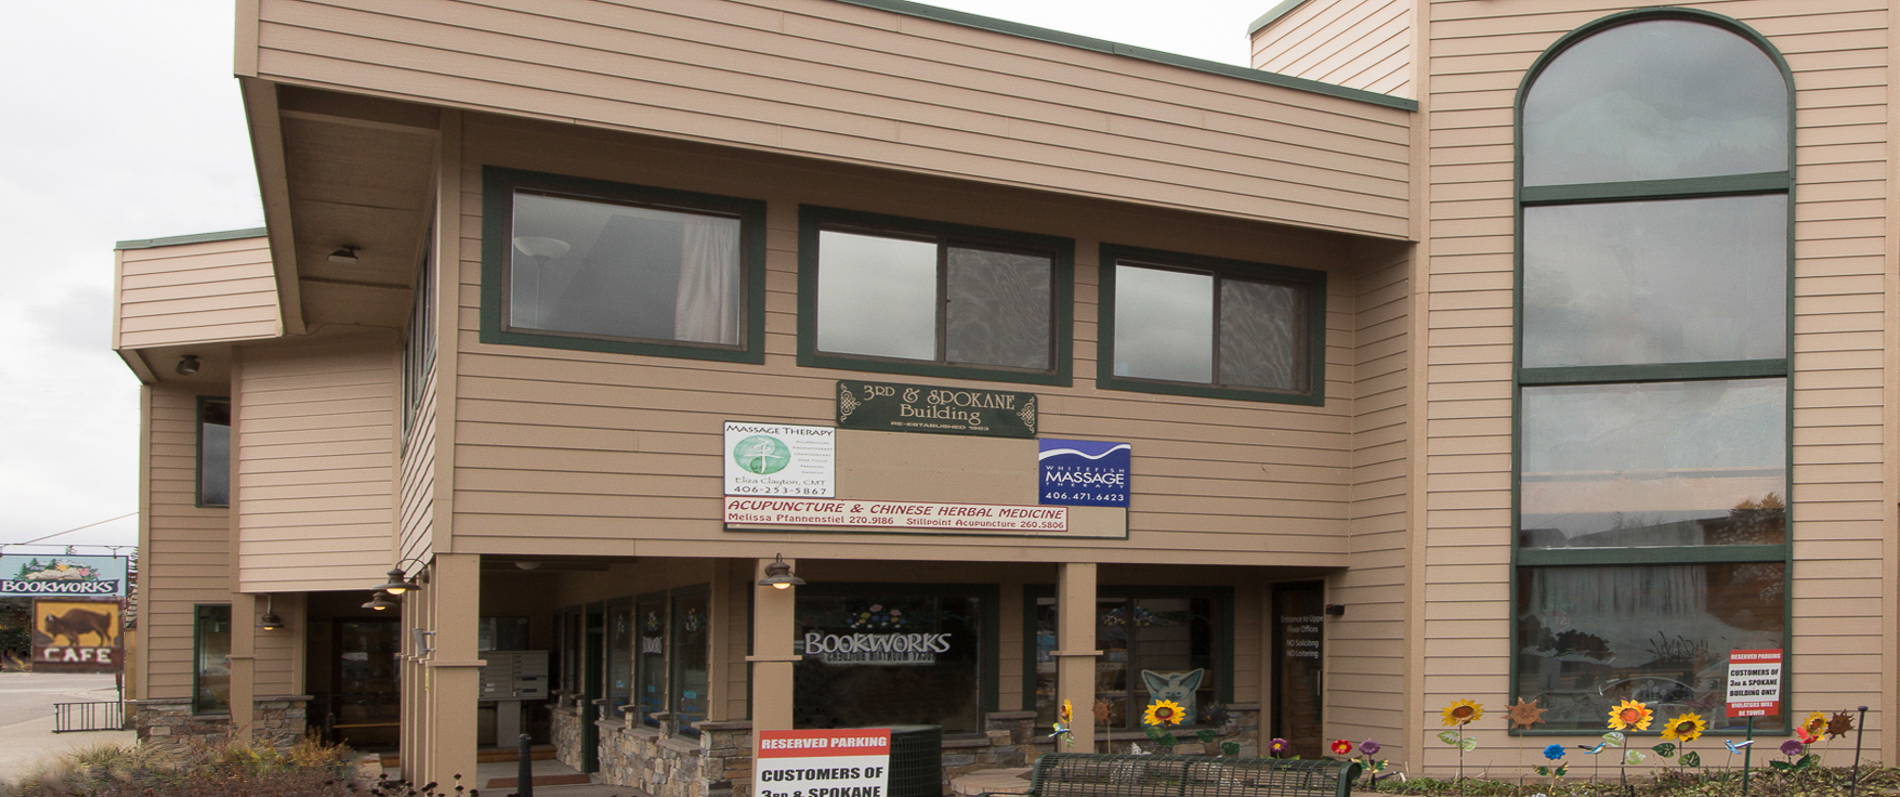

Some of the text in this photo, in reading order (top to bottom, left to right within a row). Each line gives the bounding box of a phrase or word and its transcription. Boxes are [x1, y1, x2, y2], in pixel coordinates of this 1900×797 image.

[863, 384, 1016, 411] 3RD & SPOKANE
[900, 403, 982, 426] Building
[726, 424, 833, 437] MASSAGE THERAPY
[1045, 465, 1125, 473] WHITEFISH
[735, 476, 759, 484] Eliza
[760, 477, 801, 486] Clayton,
[1045, 471, 1124, 485] MASSAGE
[734, 486, 827, 495] 406-253-5867
[1045, 491, 1125, 502] 406.471.6423
[727, 500, 1064, 520] ACUPUNCTURE & CHINESE HERBAL MEDICINE
[728, 513, 894, 525] Melissa Pfannenstiel 270.9186
[906, 518, 1064, 529] Stillpoint Acupuncture 260.5806
[2, 580, 115, 593] BOOKWORKS
[1309, 615, 1324, 624] Uppe
[804, 632, 952, 655] BOOKWORKS
[43, 647, 112, 664] CAFE
[1730, 668, 1779, 677] CUSTOMERS OF
[1729, 689, 1760, 697] BUILDING
[761, 736, 887, 750] RESERVED PARKING
[761, 766, 884, 783] CUSTOMERS OF
[808, 786, 881, 797] SPOKANE
